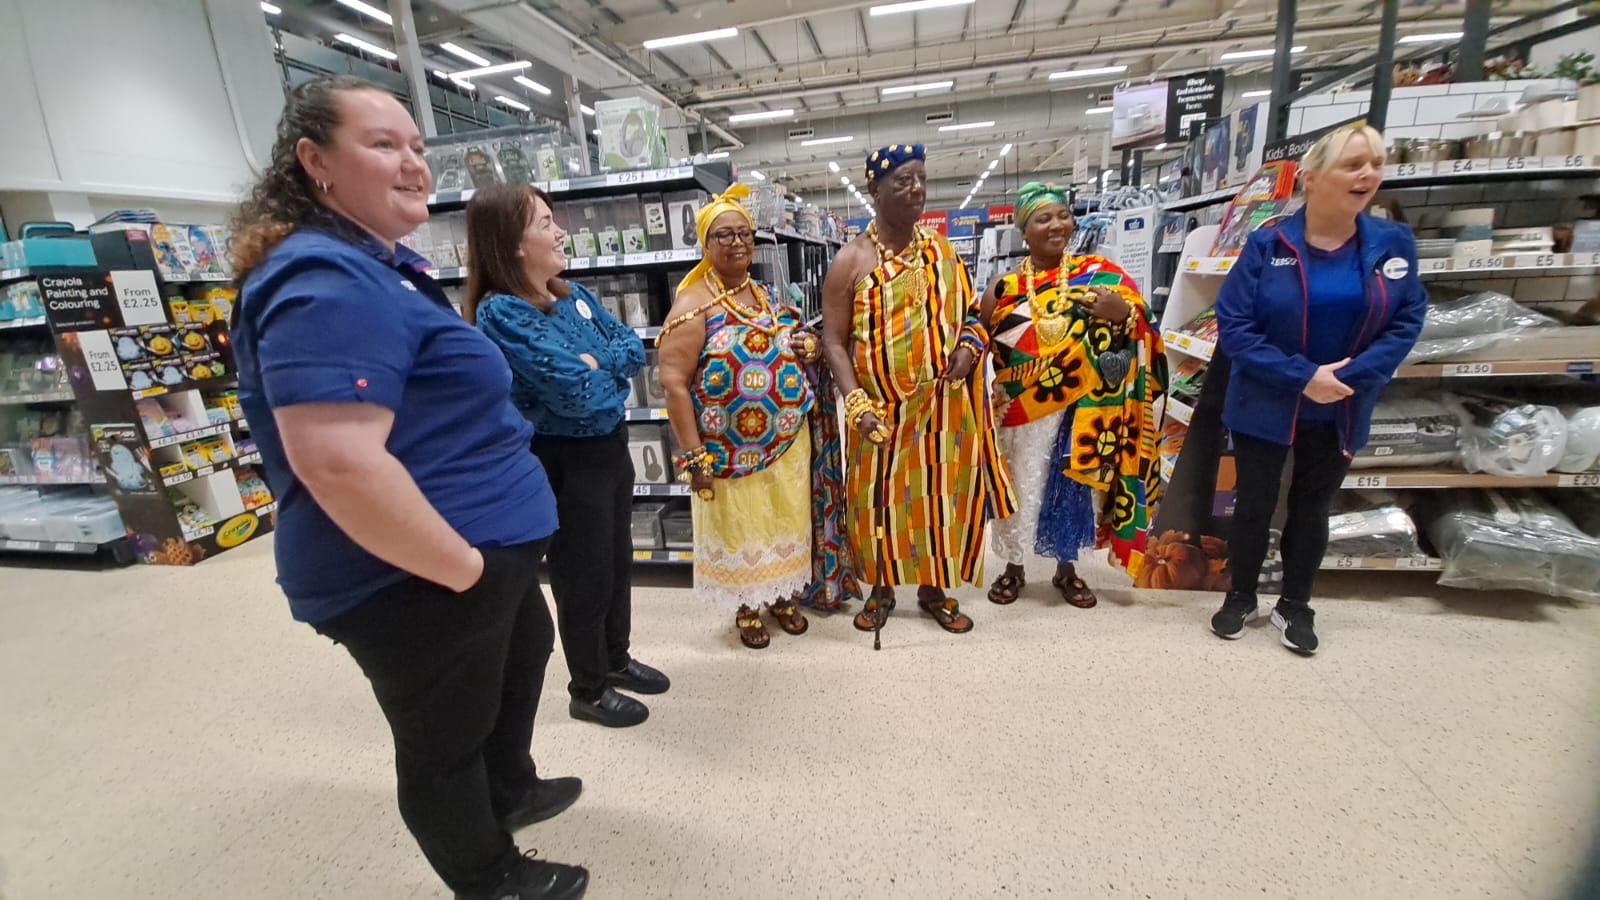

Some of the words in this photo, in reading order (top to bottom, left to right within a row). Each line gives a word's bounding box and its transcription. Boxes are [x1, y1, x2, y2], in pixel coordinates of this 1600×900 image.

[1266, 145, 1287, 161] Kids'
[1453, 160, 1473, 173] £4
[1506, 156, 1525, 169] £5
[1565, 155, 1584, 167] £6
[1397, 164, 1416, 177] £3
[618, 172, 637, 183] £25
[654, 251, 673, 262] £32
[1536, 254, 1554, 267] £5
[1468, 258, 1502, 269] £5.50
[42, 276, 83, 288] Crayola
[46, 288, 88, 299] Painting
[90, 287, 109, 296] and
[123, 288, 151, 297] From
[49, 299, 101, 310] Colouring
[123, 297, 158, 308] £2.25
[89, 350, 111, 359] From
[91, 361, 118, 372] £2.25
[1456, 364, 1490, 374] £2.50
[1357, 477, 1380, 487] £15
[1573, 475, 1599, 487] £20
[635, 486, 648, 494] 45
[1337, 558, 1353, 567] £5
